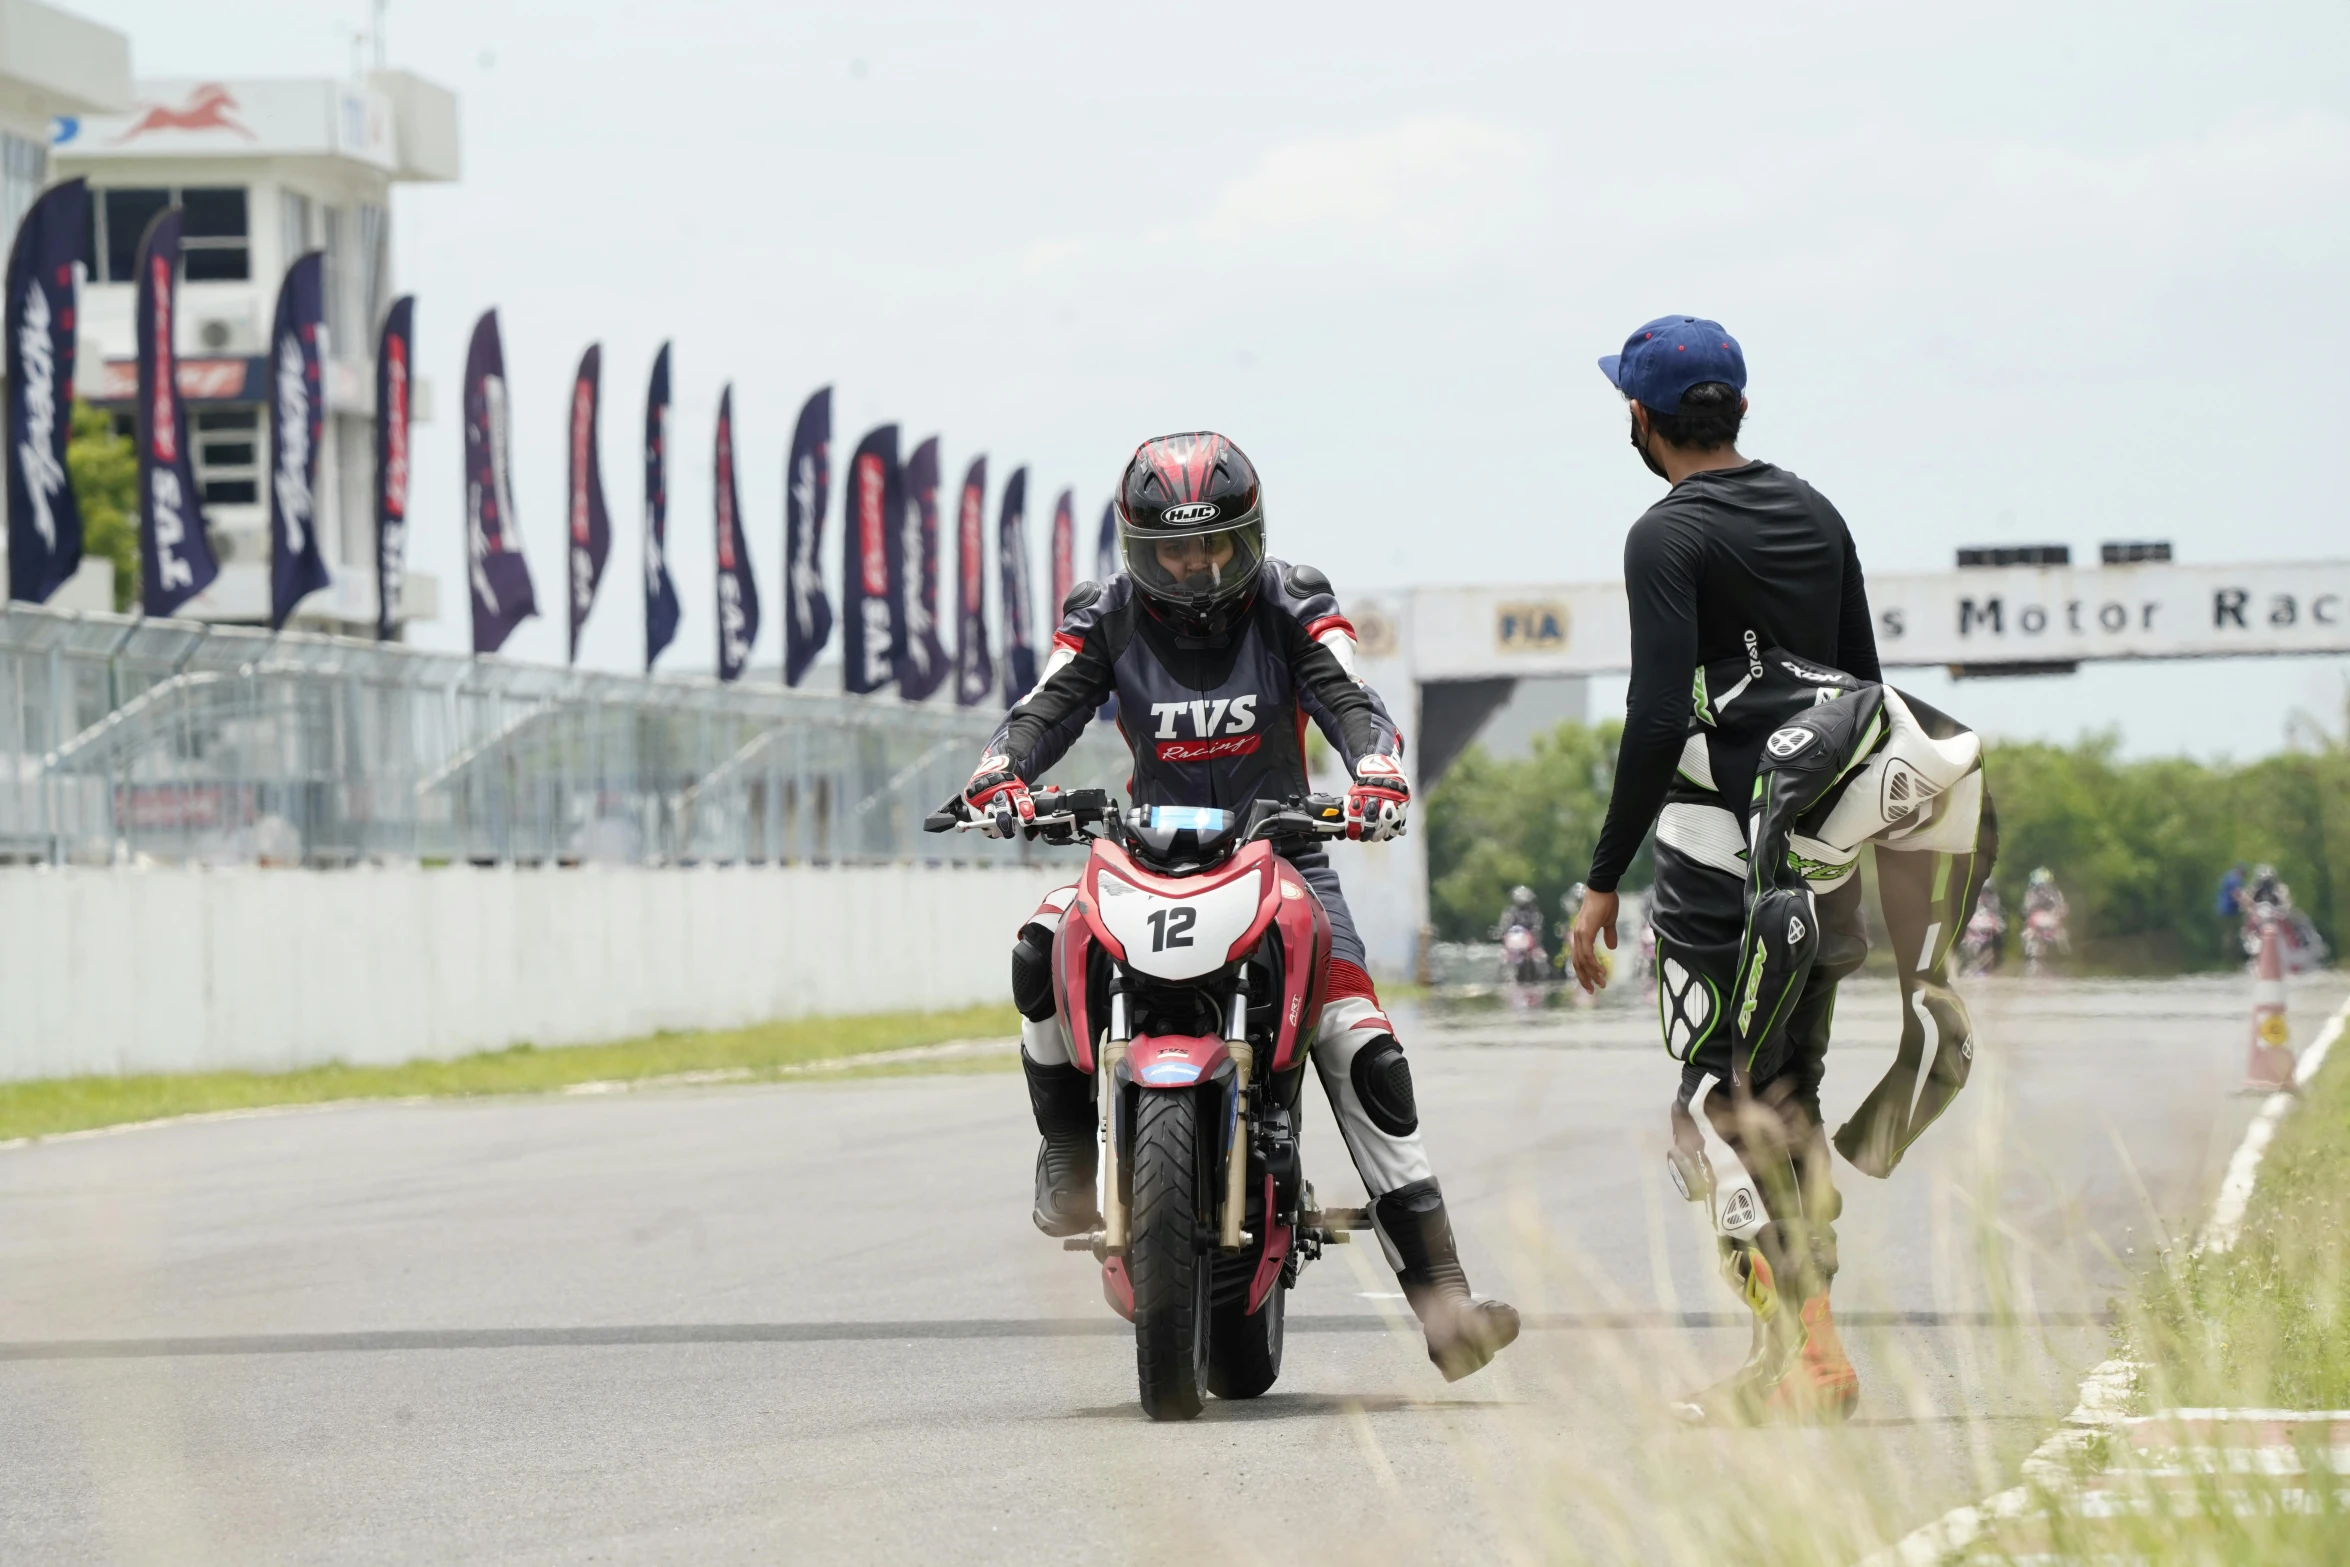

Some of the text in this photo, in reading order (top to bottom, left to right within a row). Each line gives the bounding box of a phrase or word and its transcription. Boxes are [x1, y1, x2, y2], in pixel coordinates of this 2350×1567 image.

[152, 467, 193, 592] TVS
[1169, 506, 1212, 521] HJC
[1501, 612, 1563, 641] FIA
[1958, 597, 2162, 637] Motor
[862, 597, 893, 683] TVS
[1150, 694, 1257, 739] TVS
[1162, 735, 1256, 760] Racing
[1147, 906, 1196, 953] 12
[1738, 935, 1767, 1039] IXON
